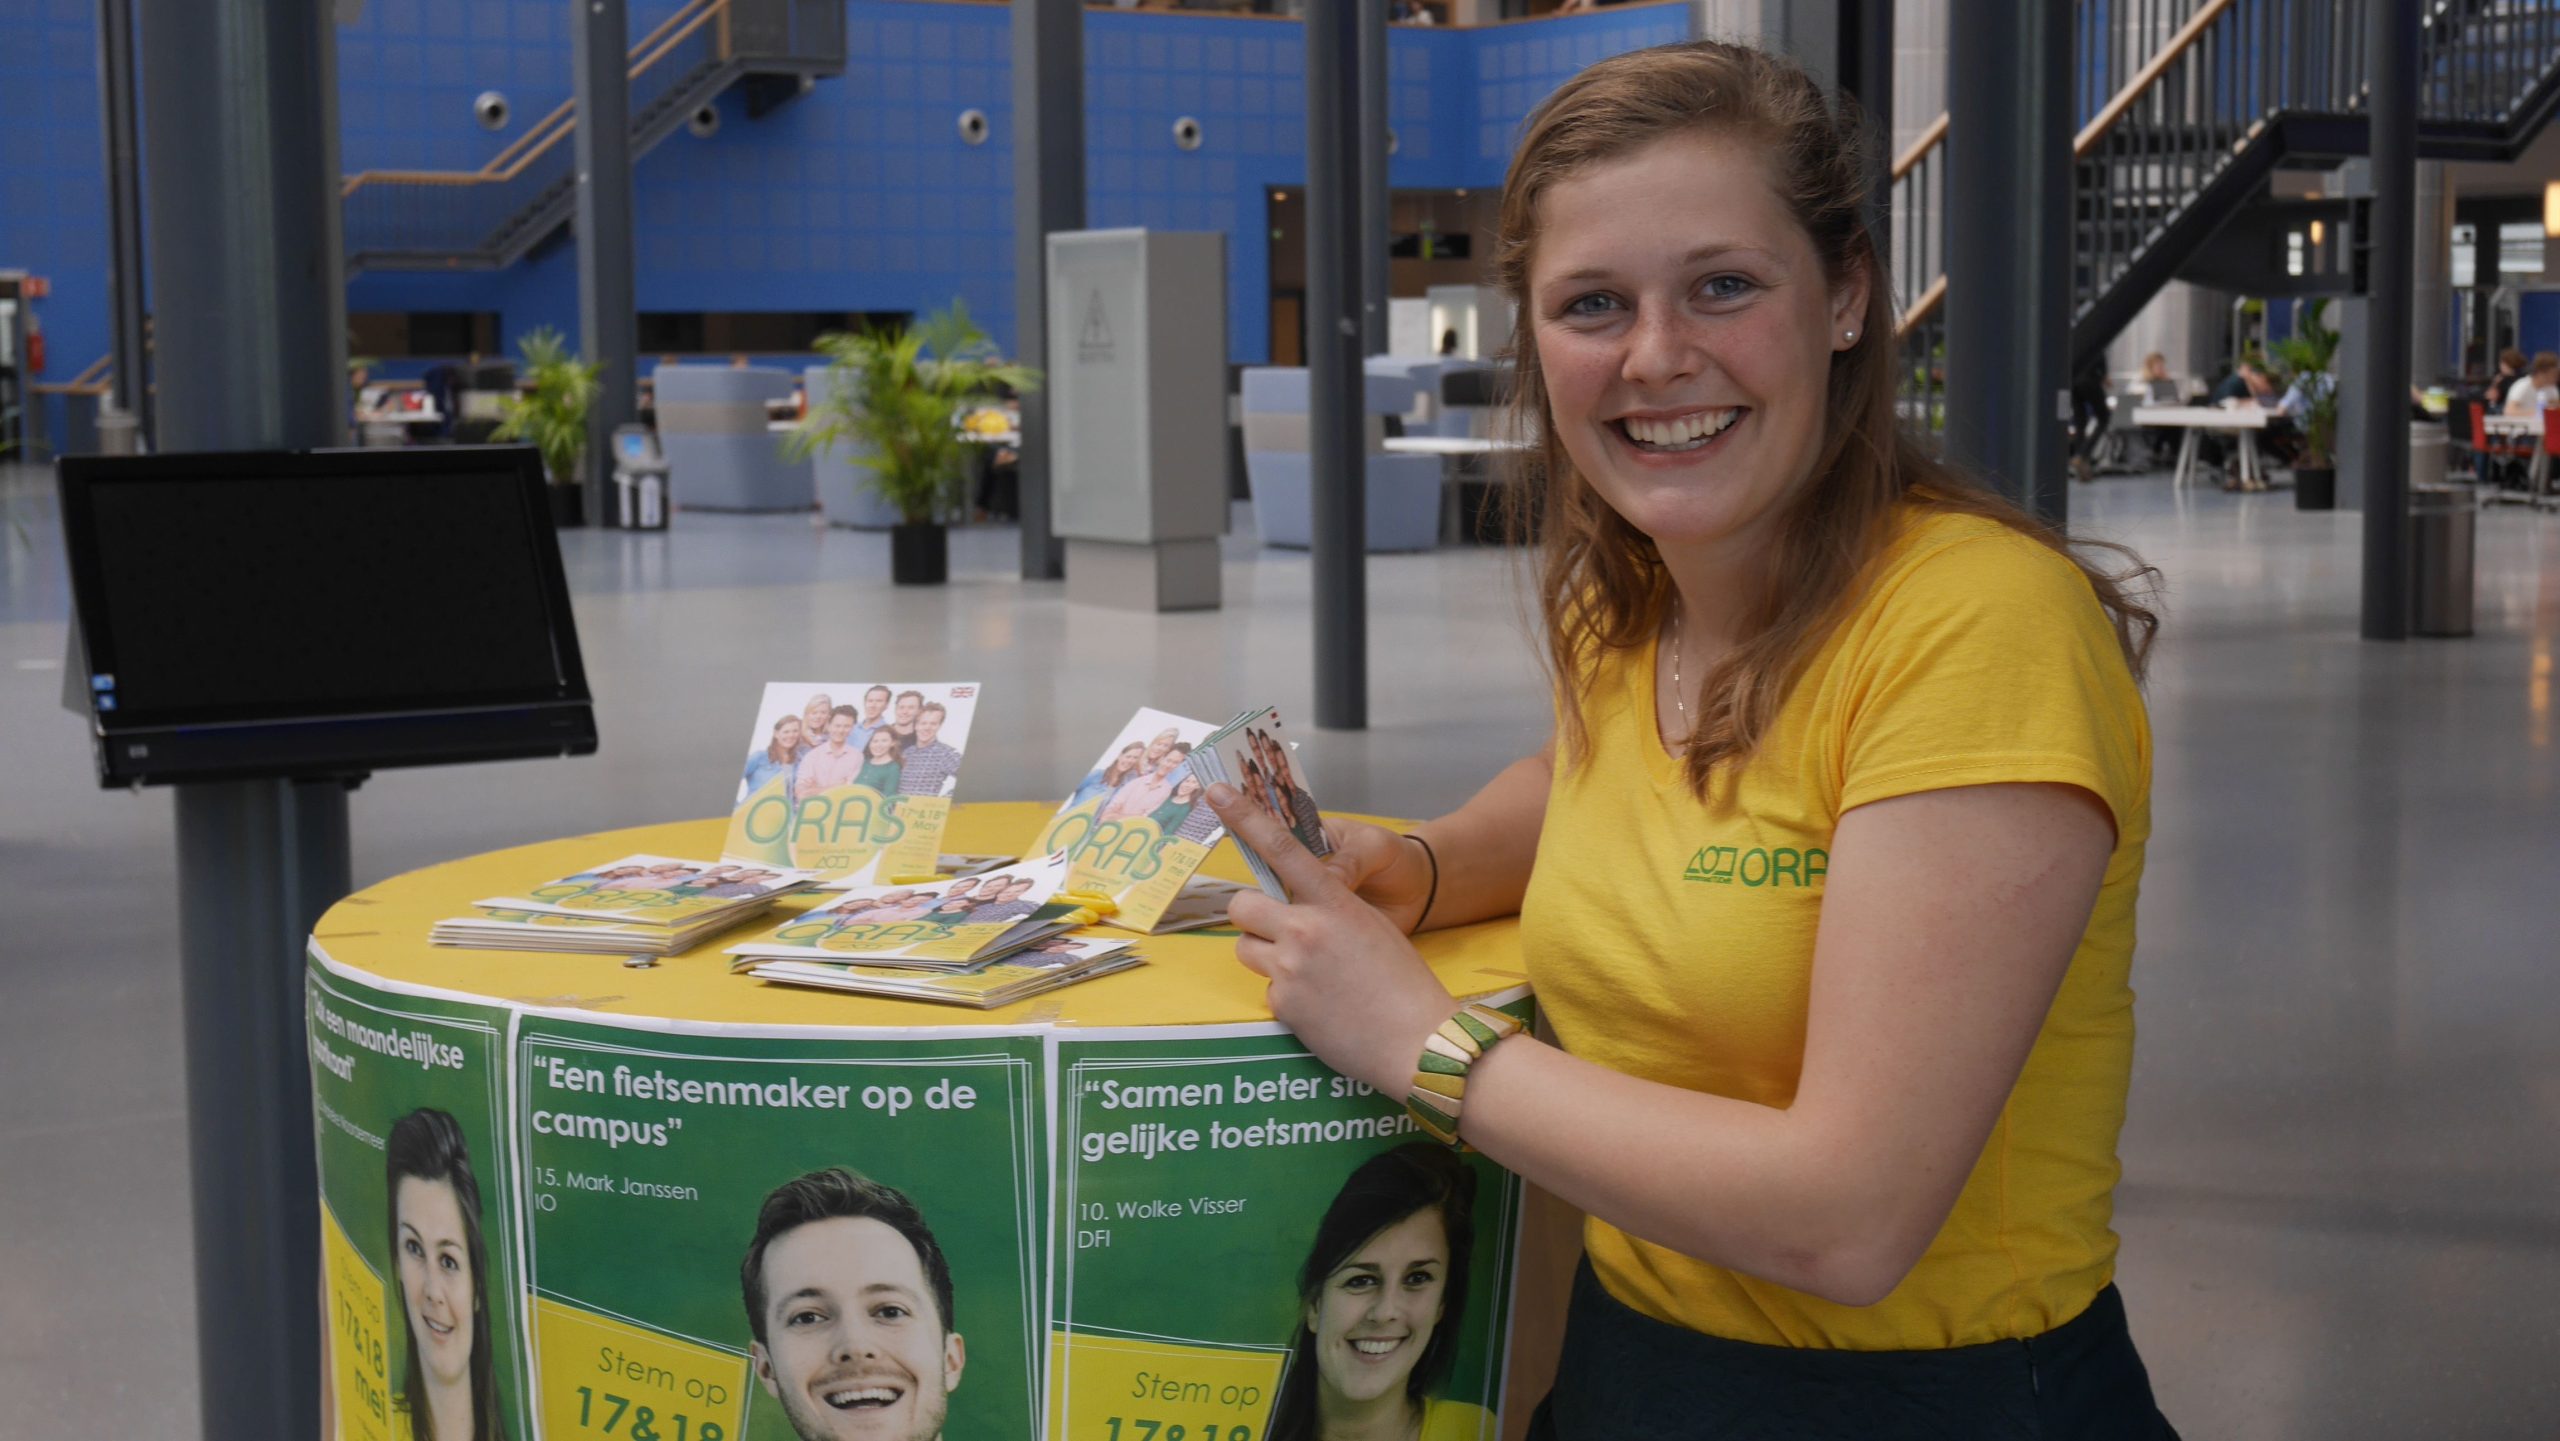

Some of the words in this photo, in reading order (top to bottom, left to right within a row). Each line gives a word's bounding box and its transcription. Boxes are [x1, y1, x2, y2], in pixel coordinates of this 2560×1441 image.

[745, 794, 909, 844] ORAS
[1047, 812, 1180, 880] ORAS
[1739, 847, 1829, 887] ORA
[775, 923, 956, 941] ORAS
[347, 1020, 465, 1070] maandelijkse
[534, 1055, 606, 1094] “Een
[613, 1065, 850, 1109] fietsenmaker
[861, 1084, 914, 1116] op
[924, 1078, 977, 1110] de
[1084, 1077, 1223, 1110] “Samen
[1234, 1073, 1322, 1105] beter
[532, 1108, 683, 1148] campus”
[1081, 1124, 1200, 1162] gelijke
[1209, 1113, 1421, 1150] toetsmomen
[534, 1166, 562, 1188] 15.
[566, 1171, 615, 1194] Mark
[619, 1180, 699, 1201] Janssen
[1079, 1202, 1110, 1222] 10.
[1116, 1198, 1182, 1219] Wolke
[1188, 1195, 1247, 1215] Visser
[1076, 1229, 1112, 1250] DFI
[355, 1367, 388, 1427] mei
[598, 1347, 675, 1391] Stem
[685, 1378, 728, 1408] op
[1132, 1371, 1211, 1404] Stem
[1219, 1383, 1261, 1411] op
